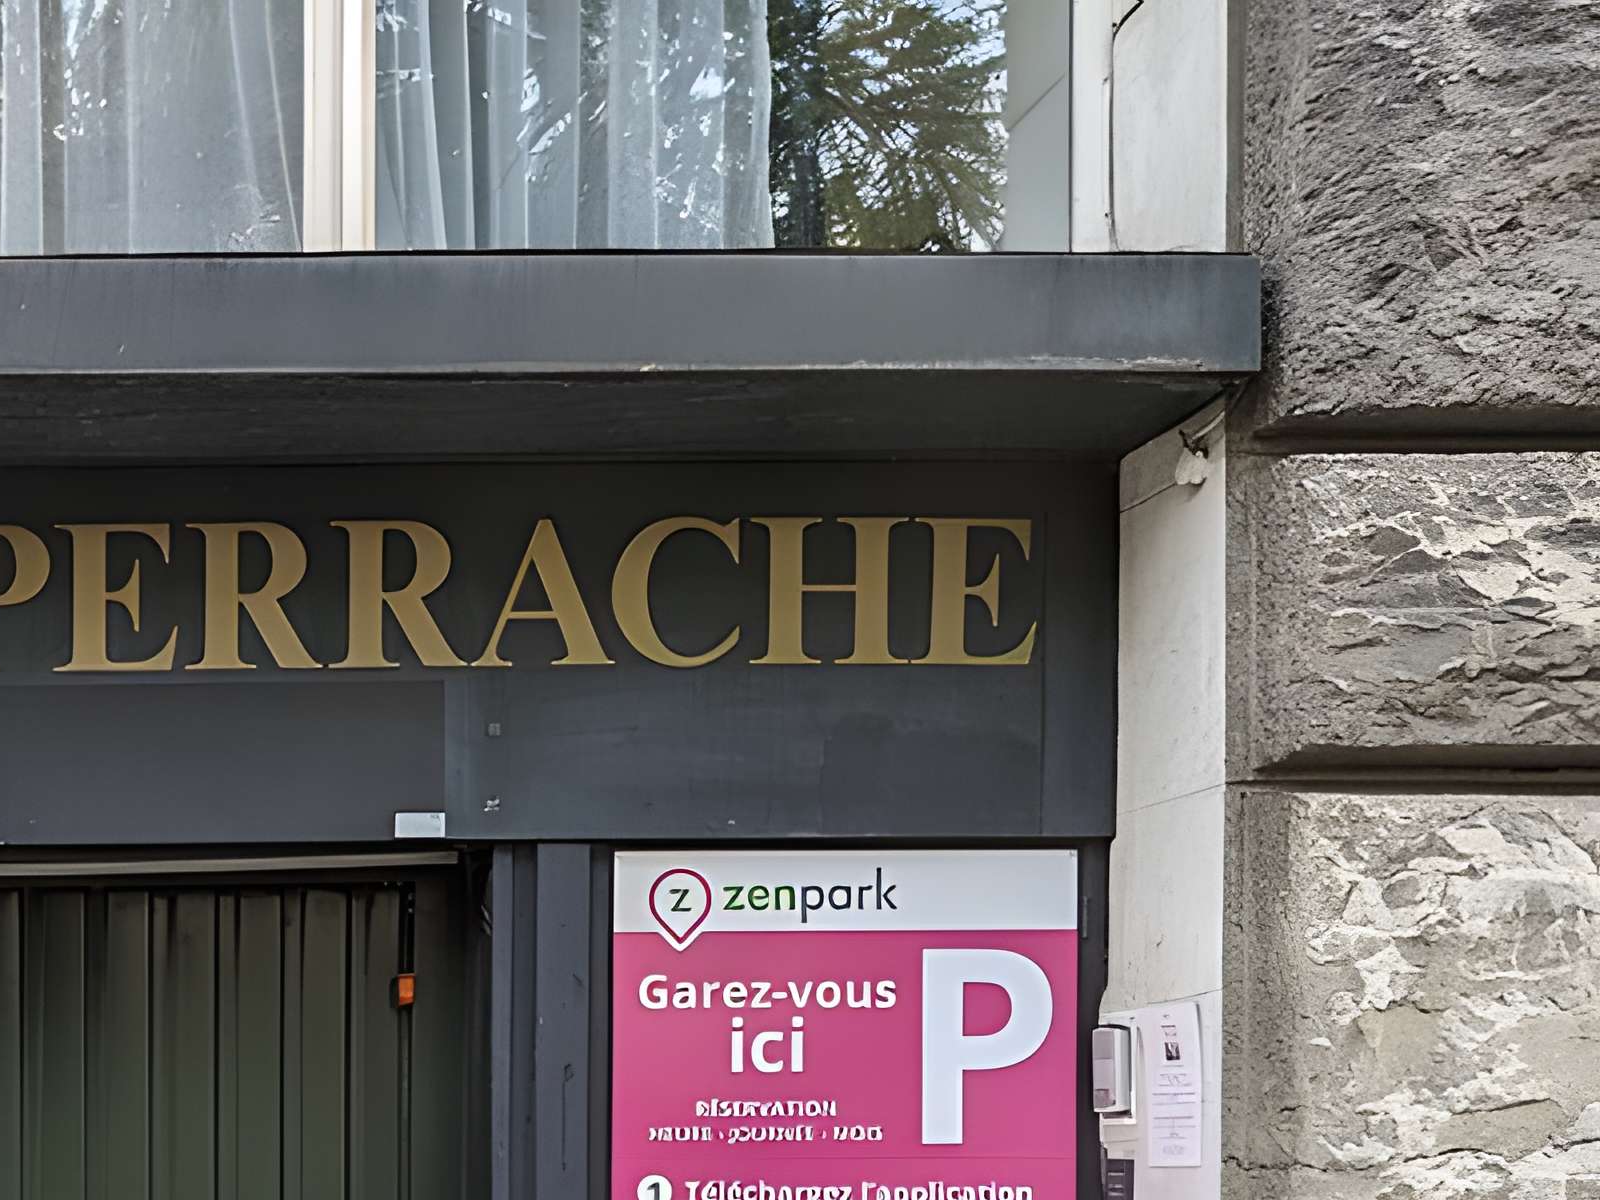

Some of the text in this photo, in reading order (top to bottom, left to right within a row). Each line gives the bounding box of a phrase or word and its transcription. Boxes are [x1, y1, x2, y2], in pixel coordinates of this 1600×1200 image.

[722, 867, 898, 924] zenpark
[638, 973, 898, 1010] Garez-vous
[730, 1016, 804, 1073] ici
[921, 948, 1054, 1145] P
